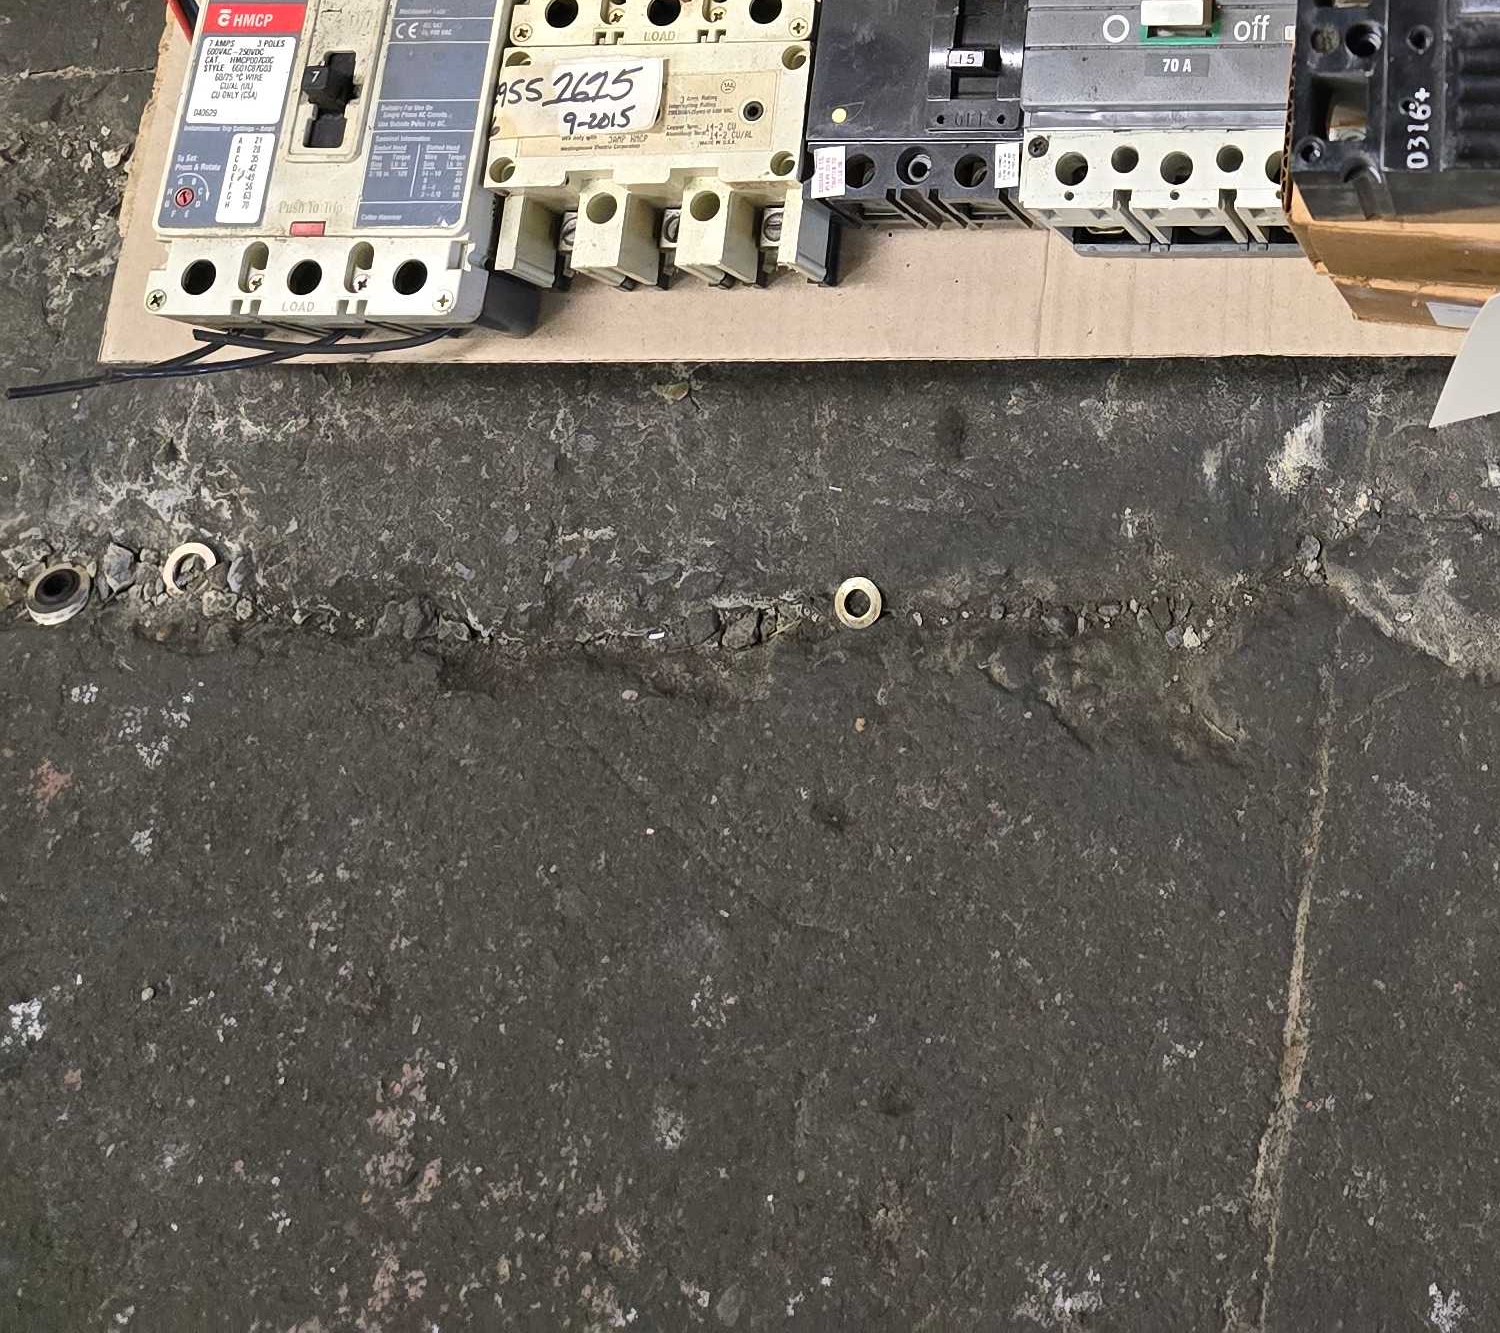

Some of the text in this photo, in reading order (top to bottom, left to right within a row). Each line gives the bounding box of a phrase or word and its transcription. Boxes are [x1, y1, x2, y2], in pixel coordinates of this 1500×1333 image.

[232, 12, 274, 28] HMCP
[1234, 14, 1269, 40] off
[643, 30, 676, 42] LOAD
[215, 39, 285, 48] AMPS POLES
[203, 65, 224, 73] STYLE
[1162, 58, 1192, 72] 70 A
[244, 74, 263, 82] WIRE
[311, 70, 320, 82] 7
[222, 91, 239, 100] ONLY
